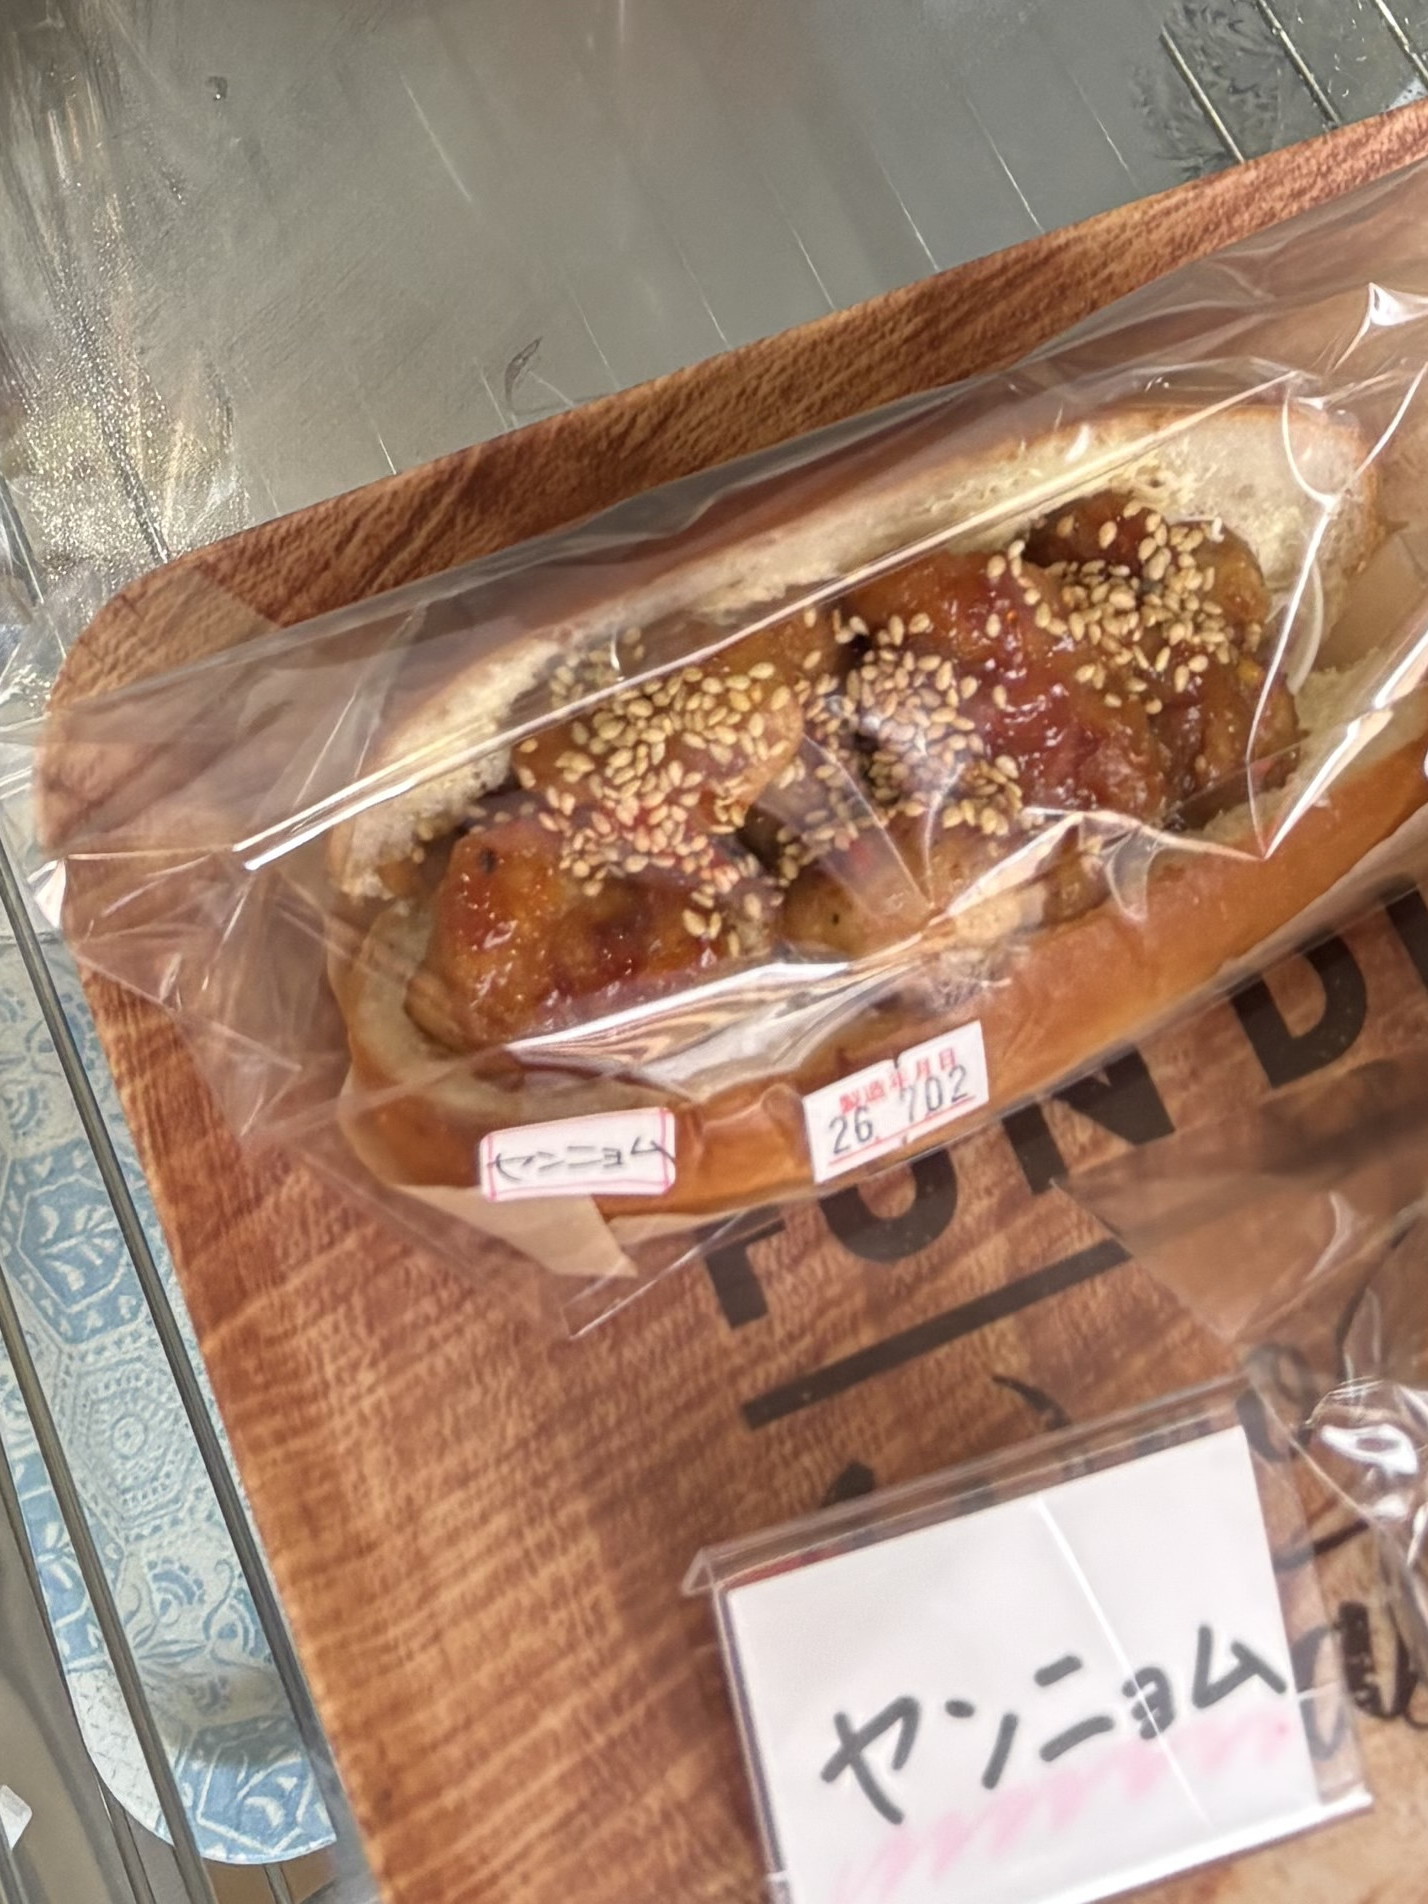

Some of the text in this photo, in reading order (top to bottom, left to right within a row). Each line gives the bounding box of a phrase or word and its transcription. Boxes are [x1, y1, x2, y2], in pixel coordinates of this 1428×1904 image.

[838, 1047, 956, 1115] 製造年月日
[486, 1135, 676, 1182] ヤンニョム
[818, 1622, 1291, 1828] ヤンニョム
